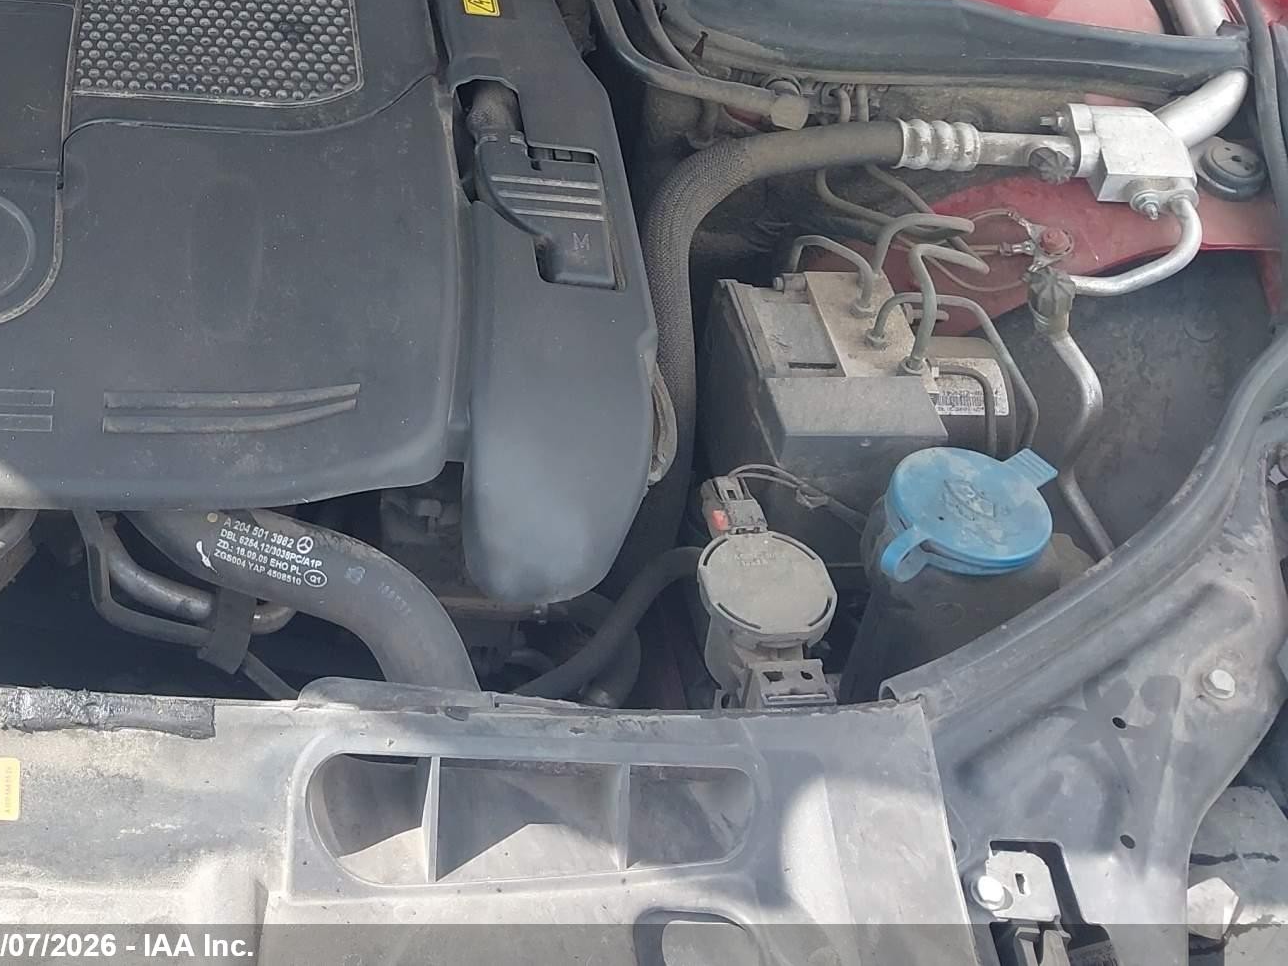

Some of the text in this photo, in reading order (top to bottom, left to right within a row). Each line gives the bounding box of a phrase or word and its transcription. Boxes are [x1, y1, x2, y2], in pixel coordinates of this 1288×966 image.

[220, 528, 238, 543] DBL
[223, 517, 232, 528] A
[233, 520, 251, 534] 204
[252, 526, 269, 541] 501
[290, 564, 302, 576] PL
